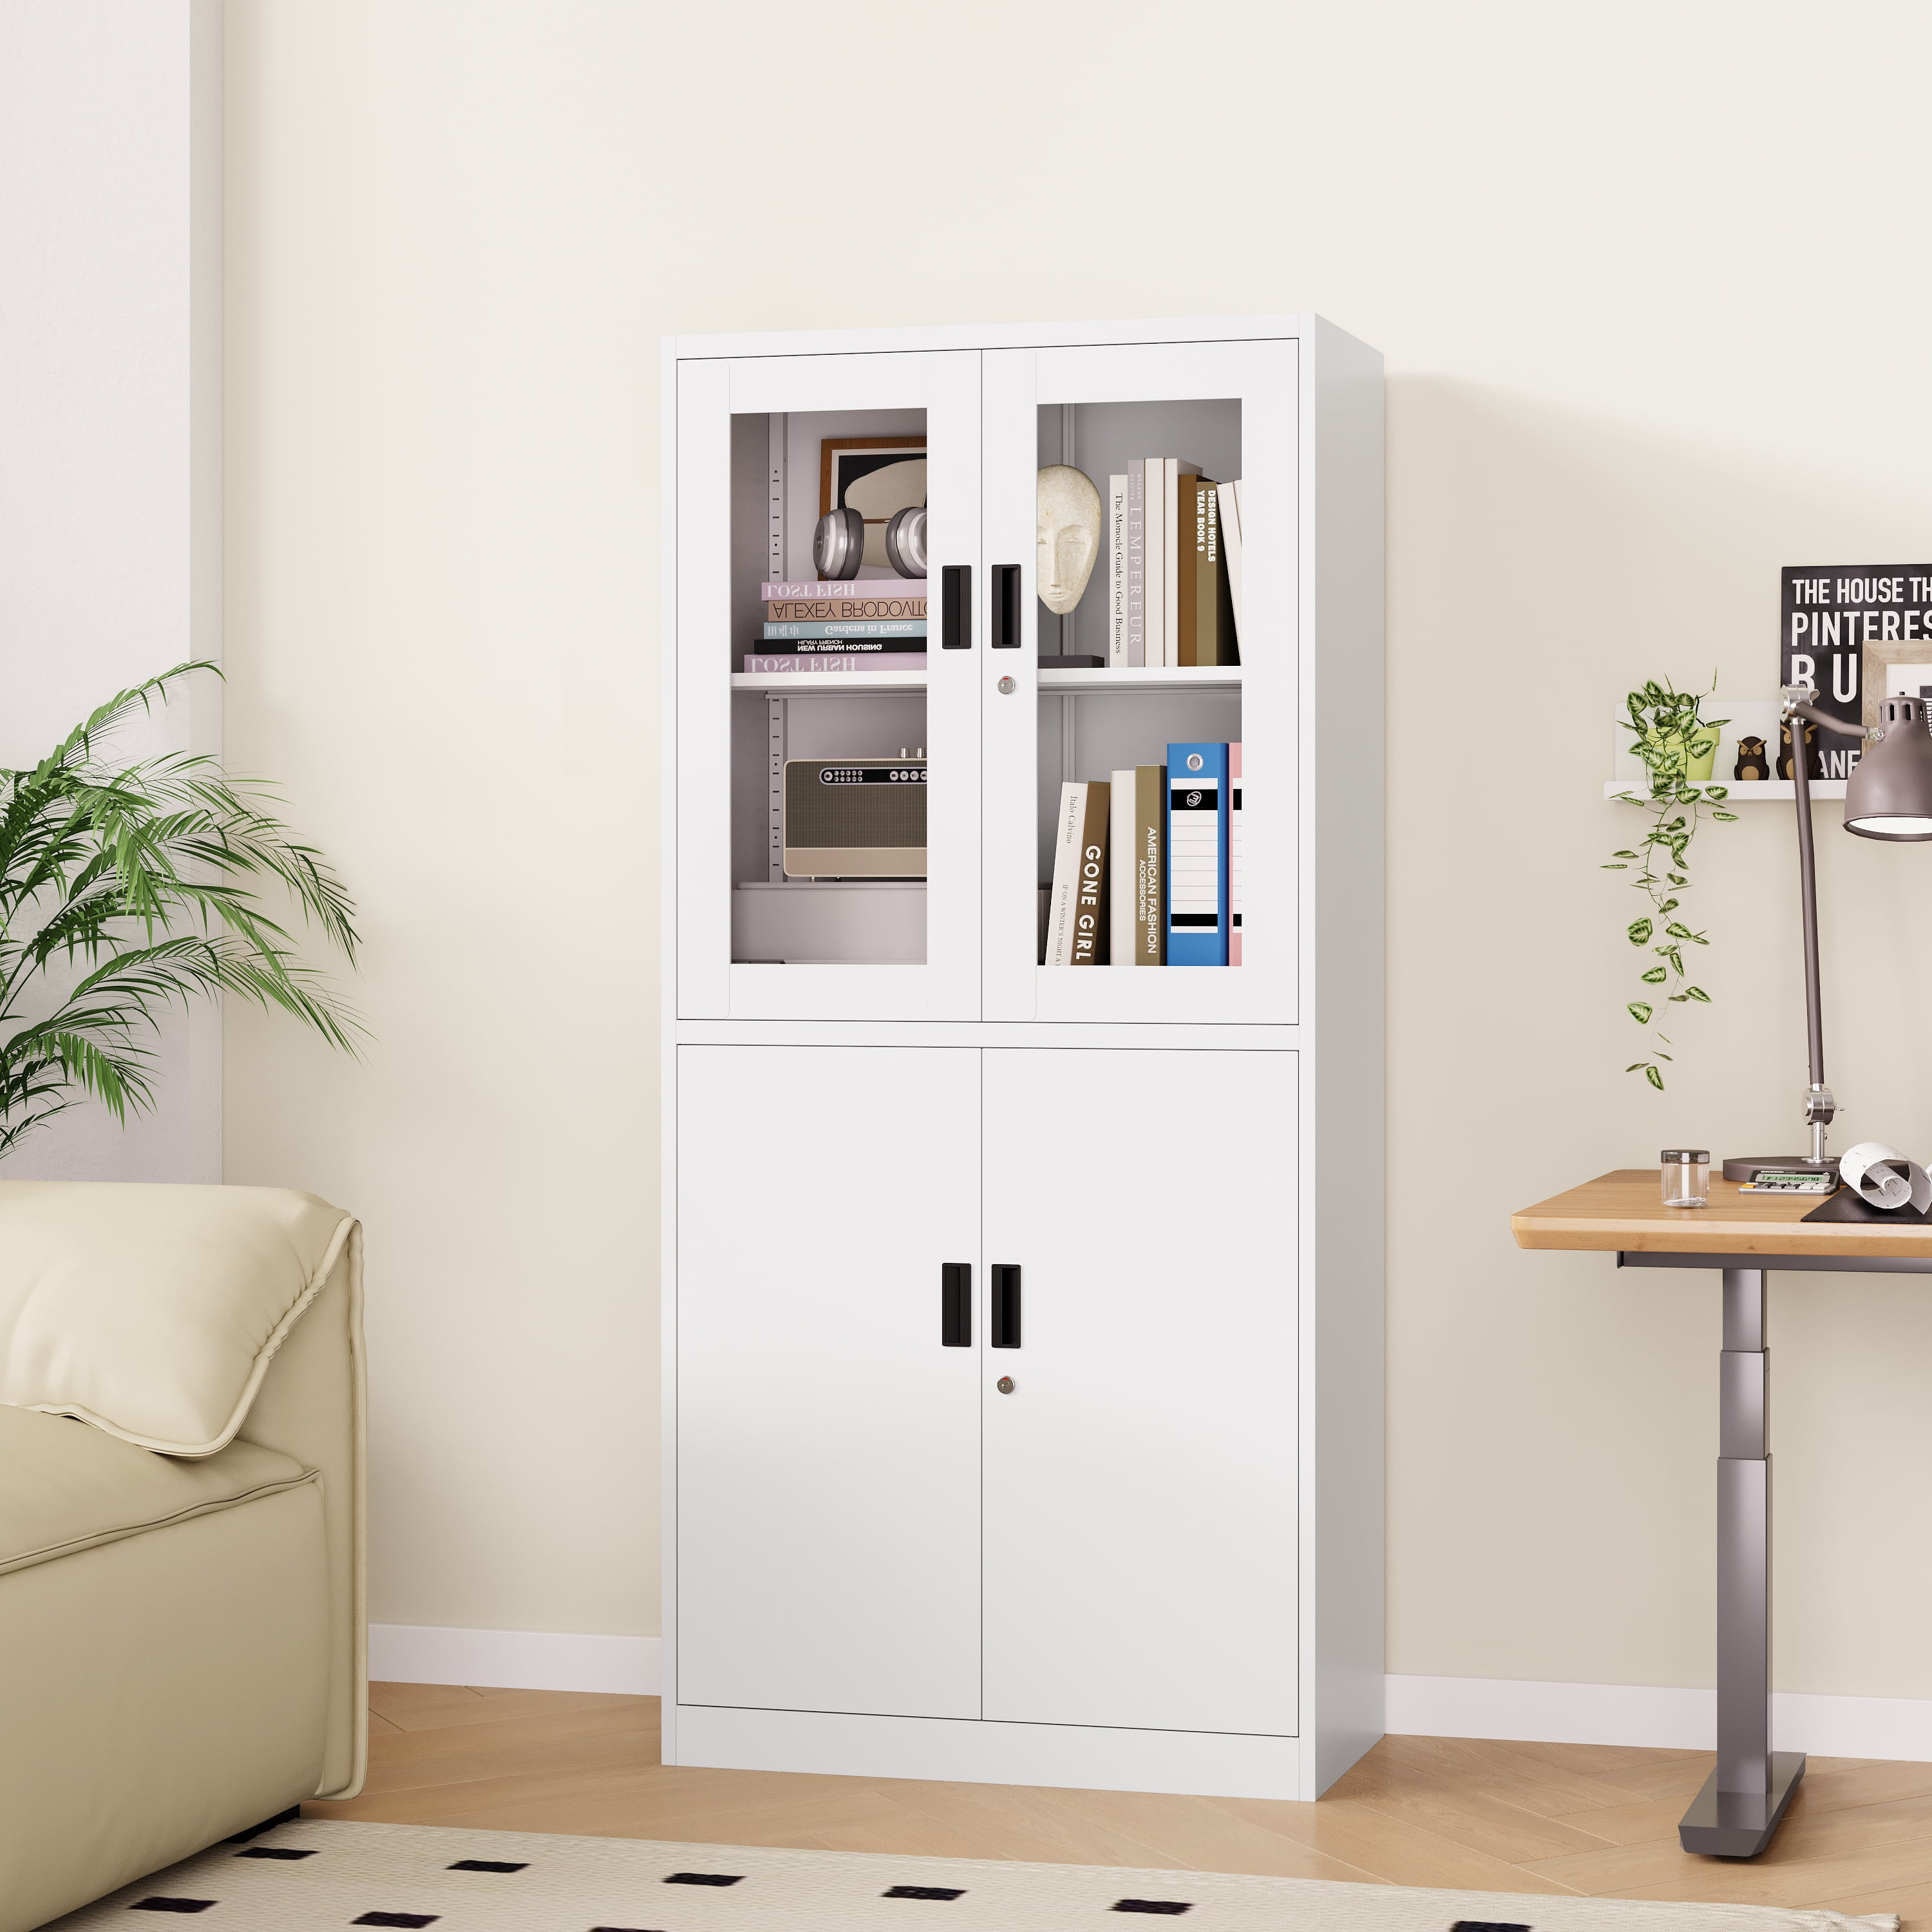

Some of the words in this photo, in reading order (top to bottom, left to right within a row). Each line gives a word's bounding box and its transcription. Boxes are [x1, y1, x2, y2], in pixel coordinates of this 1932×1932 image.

[1197, 489, 1205, 515] YEAR
[1208, 489, 1216, 525] DESIGN
[1197, 517, 1205, 544] BOOK
[1208, 527, 1216, 563] HOTELS
[1130, 506, 1141, 645] LEMPEREUR
[1792, 578, 1830, 604] THE
[1837, 577, 1904, 603] HOUSE
[1909, 577, 1932, 602] TH
[1069, 796, 1077, 813] Italo
[1066, 815, 1076, 844] Calvino
[1081, 845, 1101, 906] GONE
[1148, 826, 1157, 895] AMERICAN
[1061, 891, 1068, 901] ON
[1075, 914, 1095, 960] GIRL
[1148, 898, 1157, 954] FASHION
